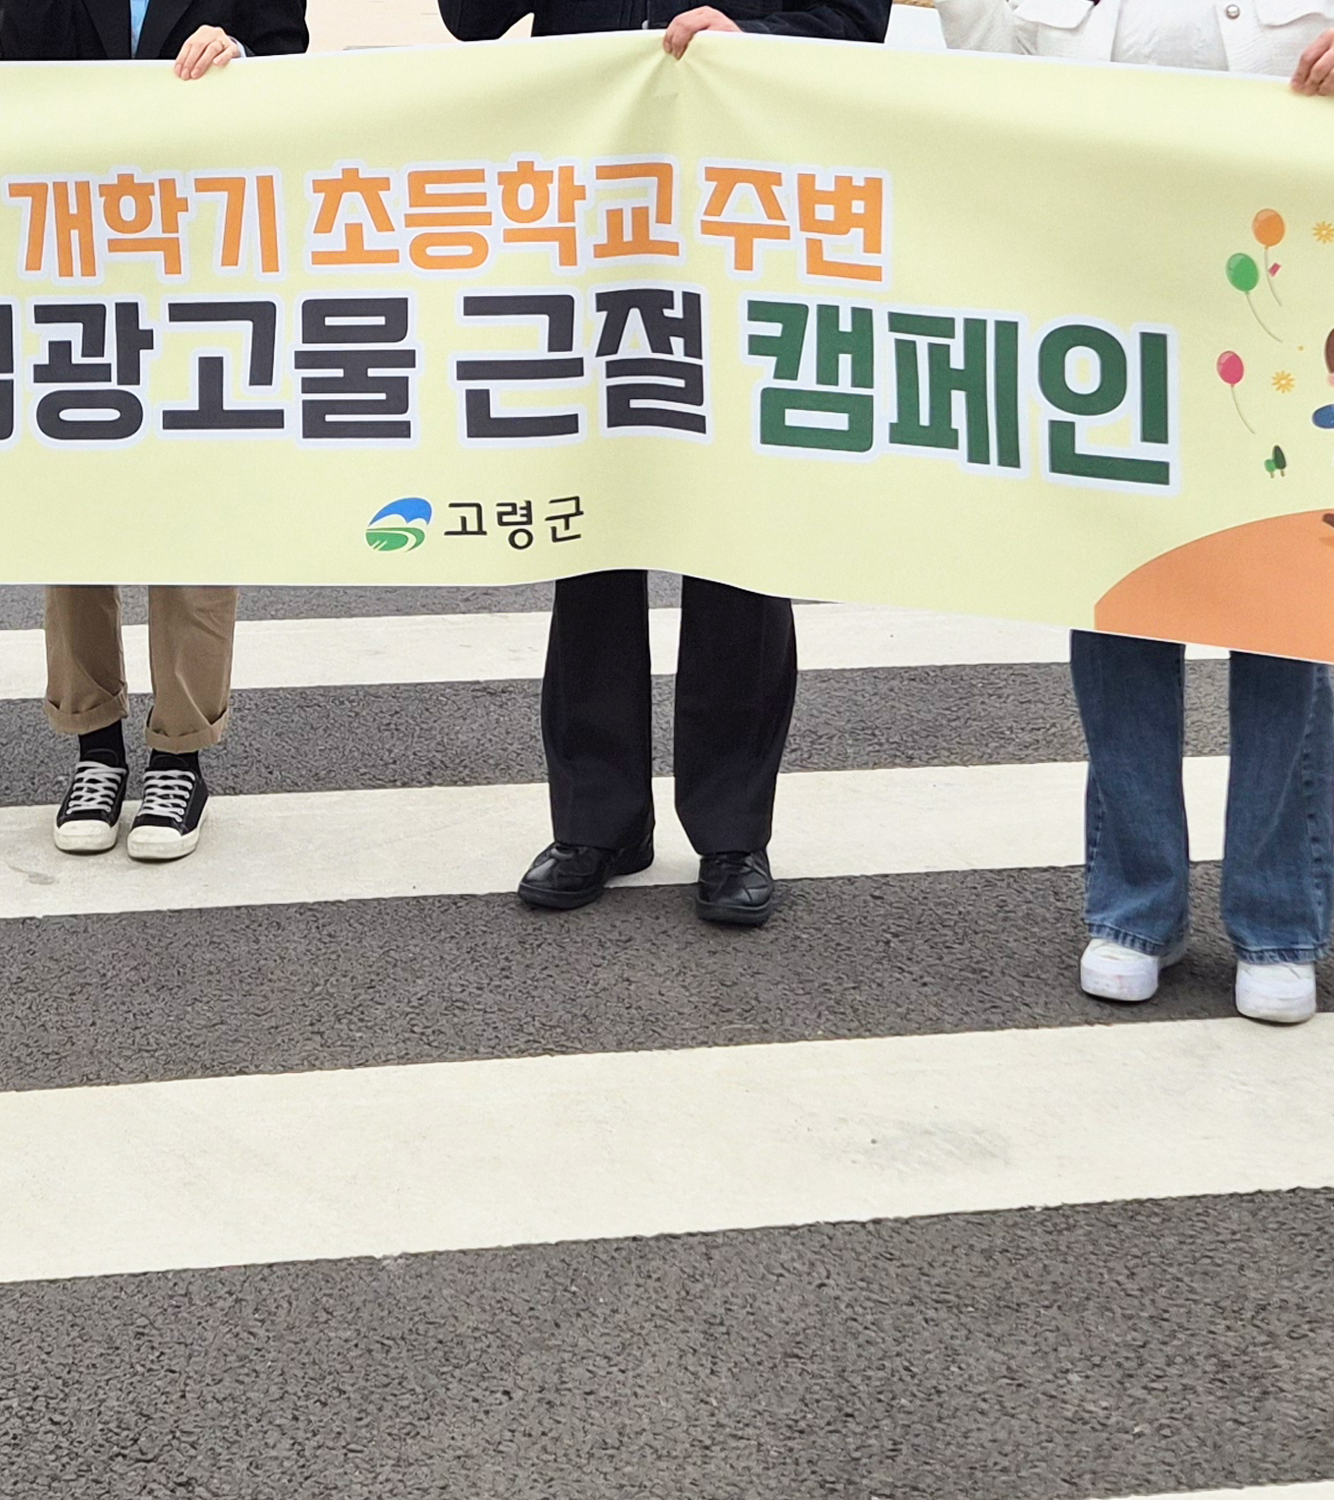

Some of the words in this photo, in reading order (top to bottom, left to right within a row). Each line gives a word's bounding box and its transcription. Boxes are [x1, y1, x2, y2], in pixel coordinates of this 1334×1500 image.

[8, 174, 279, 278] 개학기
[310, 160, 680, 270] 초등학교
[701, 166, 884, 282] 주변
[457, 288, 706, 439] 근절
[746, 299, 1171, 486] 캠페인
[443, 495, 584, 550] 고령군
